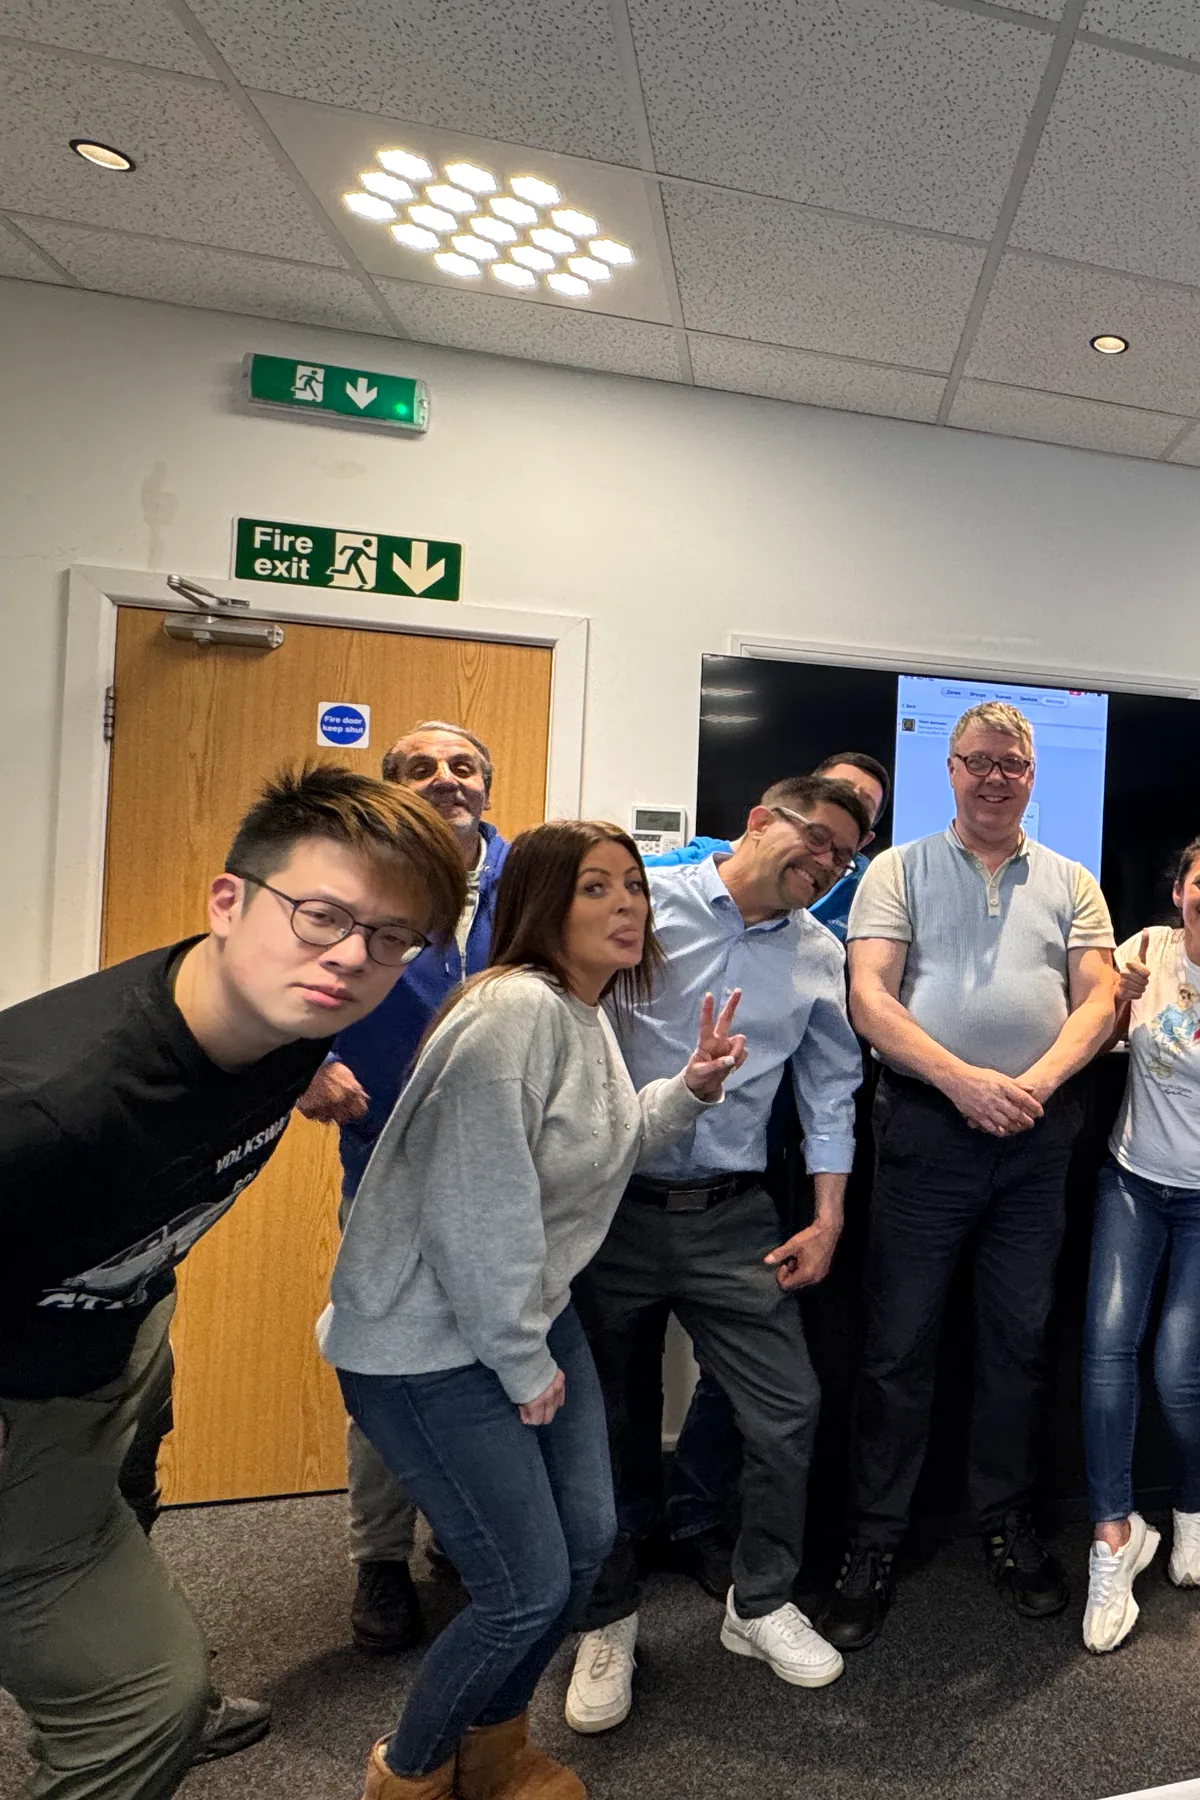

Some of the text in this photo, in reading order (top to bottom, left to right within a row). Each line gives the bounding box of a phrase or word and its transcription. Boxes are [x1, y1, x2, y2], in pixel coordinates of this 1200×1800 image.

[254, 526, 313, 554] Fire
[254, 557, 310, 580] exit
[324, 715, 341, 723] Fire
[322, 724, 343, 734] keep
